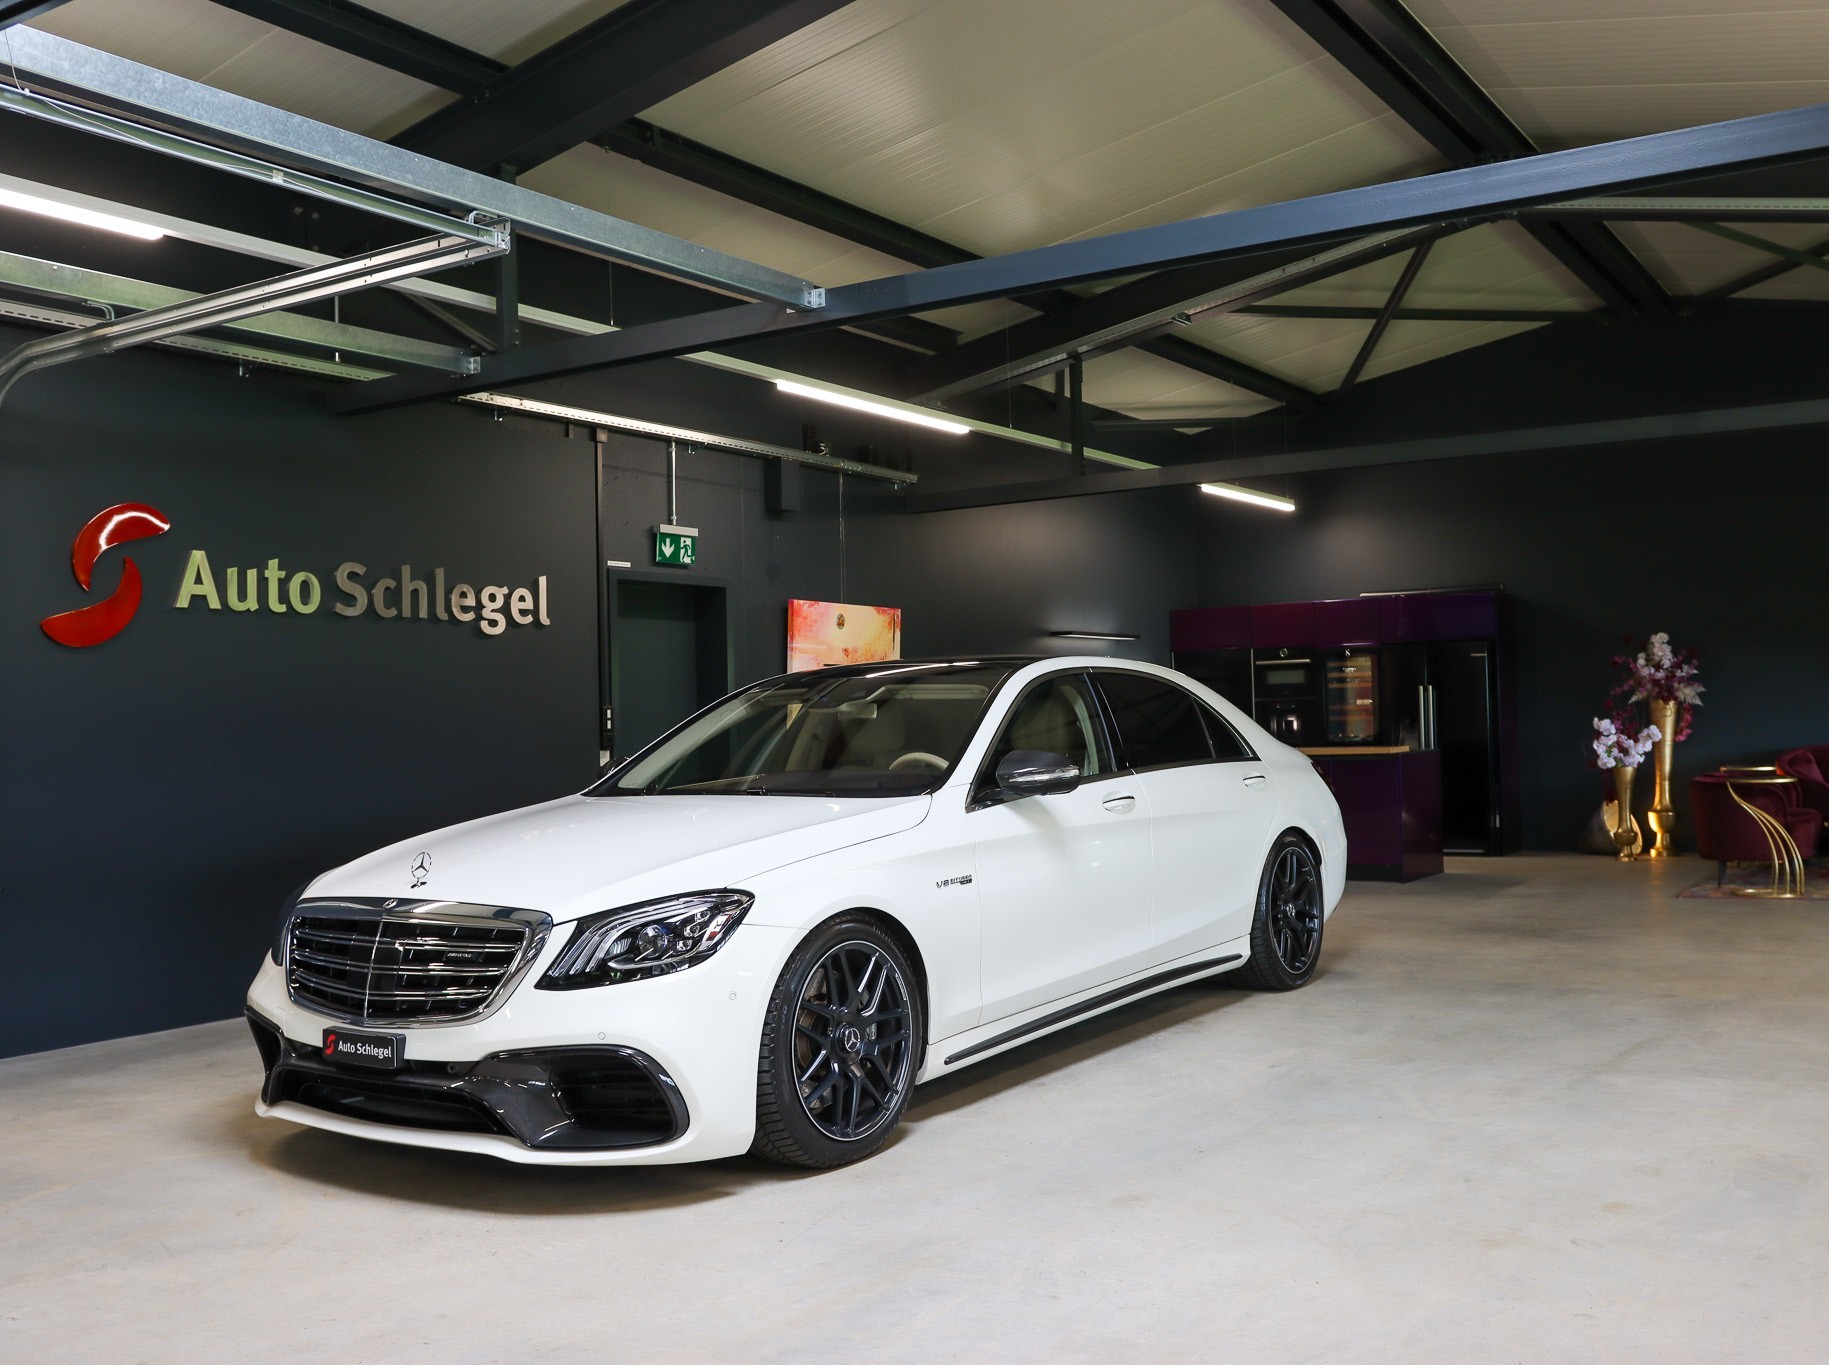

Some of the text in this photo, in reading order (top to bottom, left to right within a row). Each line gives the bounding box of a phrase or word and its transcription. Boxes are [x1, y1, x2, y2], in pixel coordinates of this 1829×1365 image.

[174, 550, 551, 635] Auto Schlegel
[338, 1040, 392, 1059] Auto Schlegel
